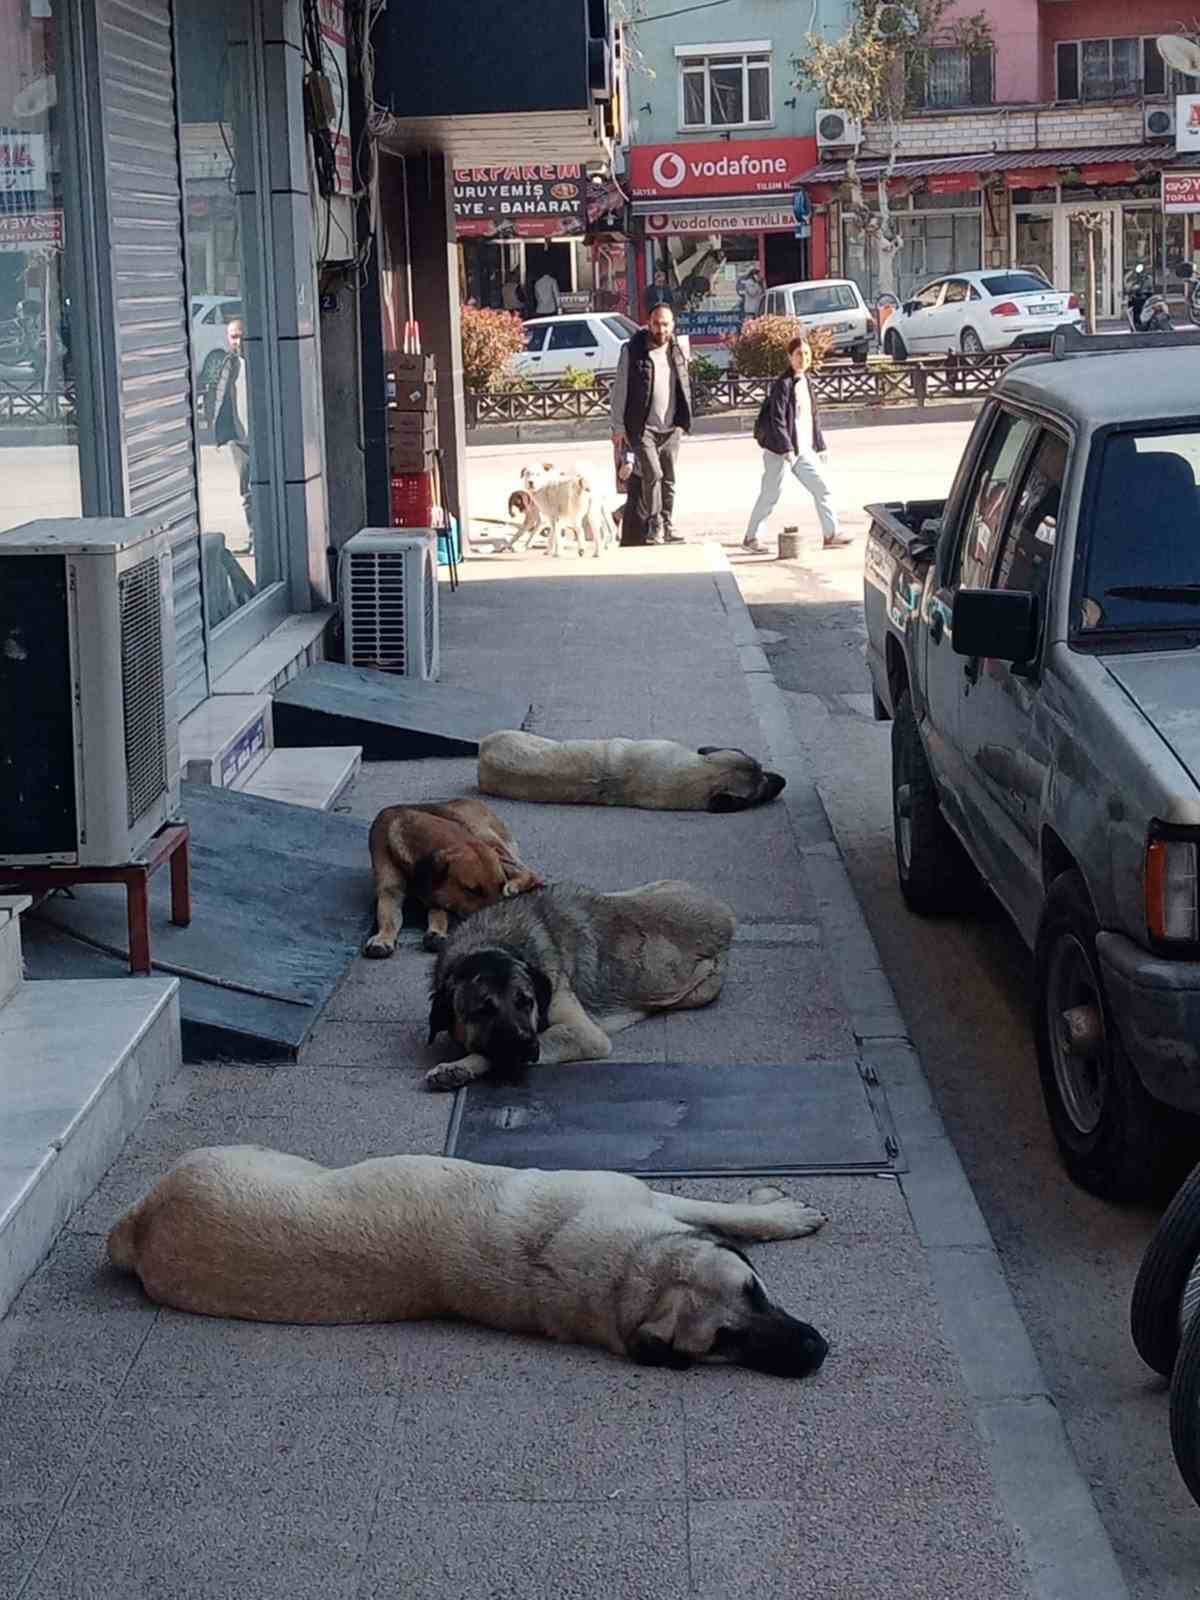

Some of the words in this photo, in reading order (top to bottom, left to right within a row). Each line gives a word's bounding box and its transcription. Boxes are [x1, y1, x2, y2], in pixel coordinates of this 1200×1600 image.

[690, 155, 787, 177] vodafone
[500, 200, 580, 214] BAHARAT
[672, 215, 738, 230] vodafone
[743, 212, 780, 226] YETKİLİ
